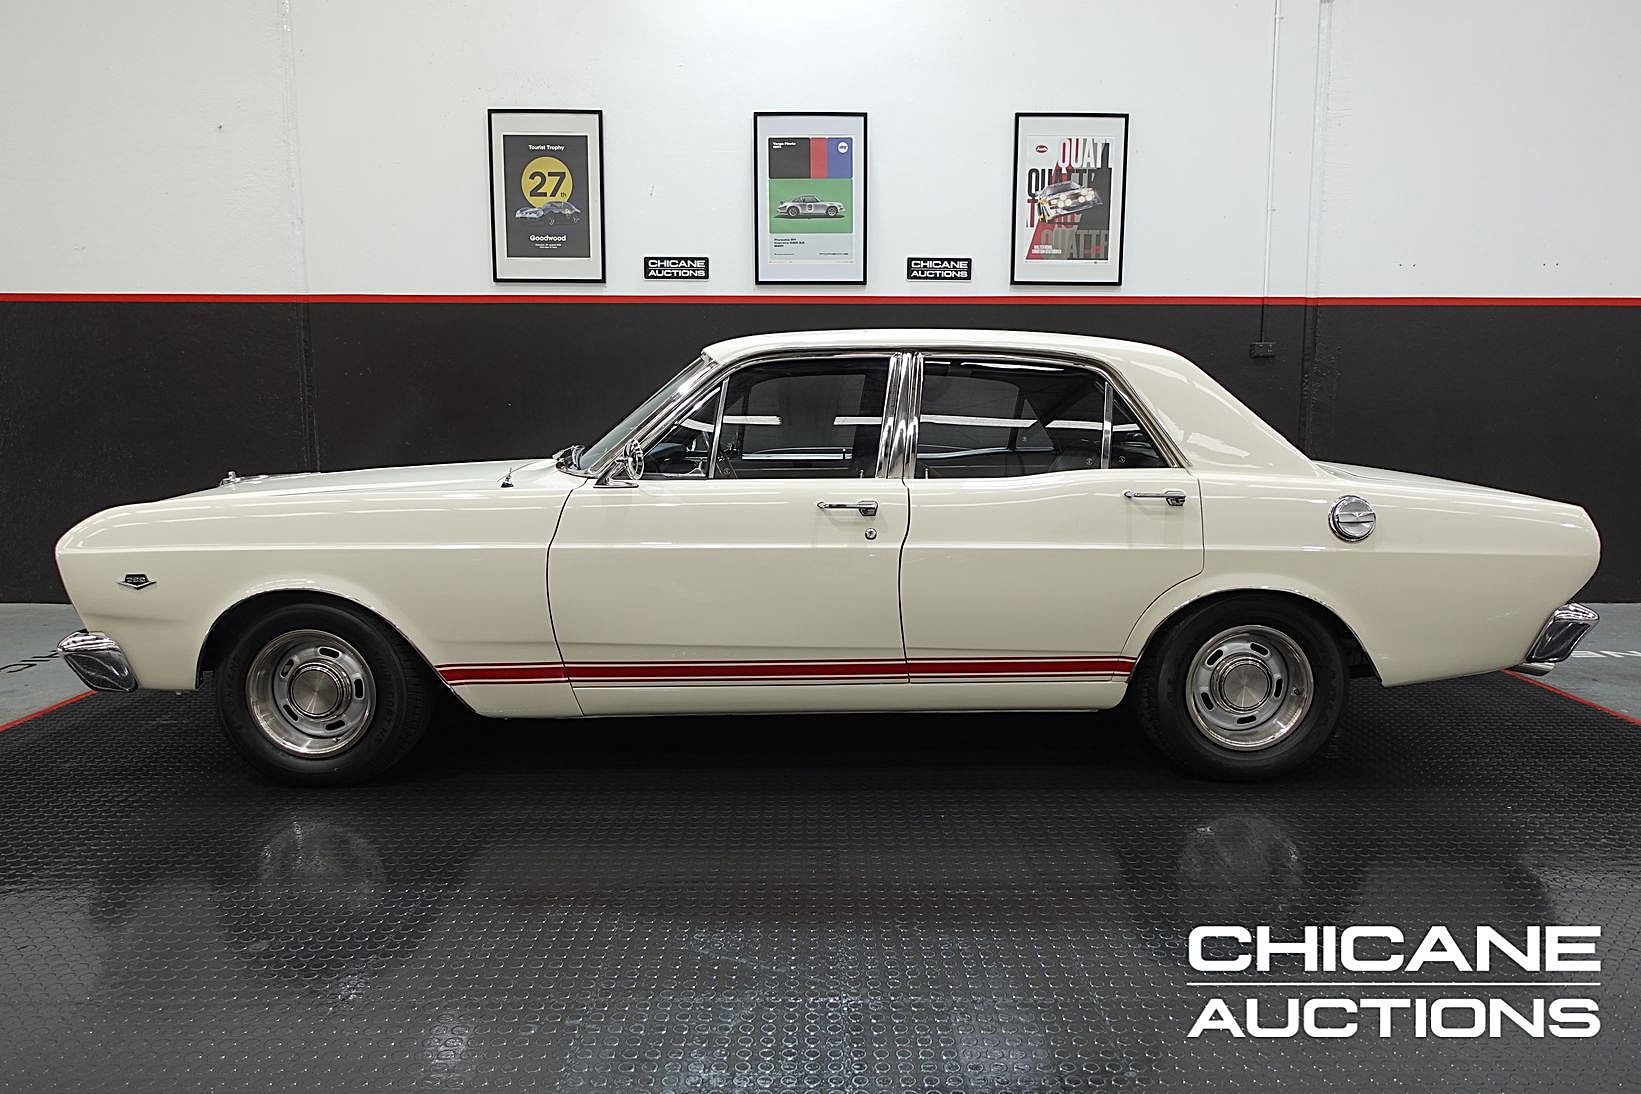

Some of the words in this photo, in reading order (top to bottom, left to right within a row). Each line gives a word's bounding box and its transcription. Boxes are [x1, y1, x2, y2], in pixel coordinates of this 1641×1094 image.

[529, 234, 567, 242] Goodwood
[648, 259, 706, 268] CHICANE
[911, 260, 969, 269] CHICANE
[648, 269, 706, 277] AUCTIONS
[910, 270, 968, 278] AUCTIONS
